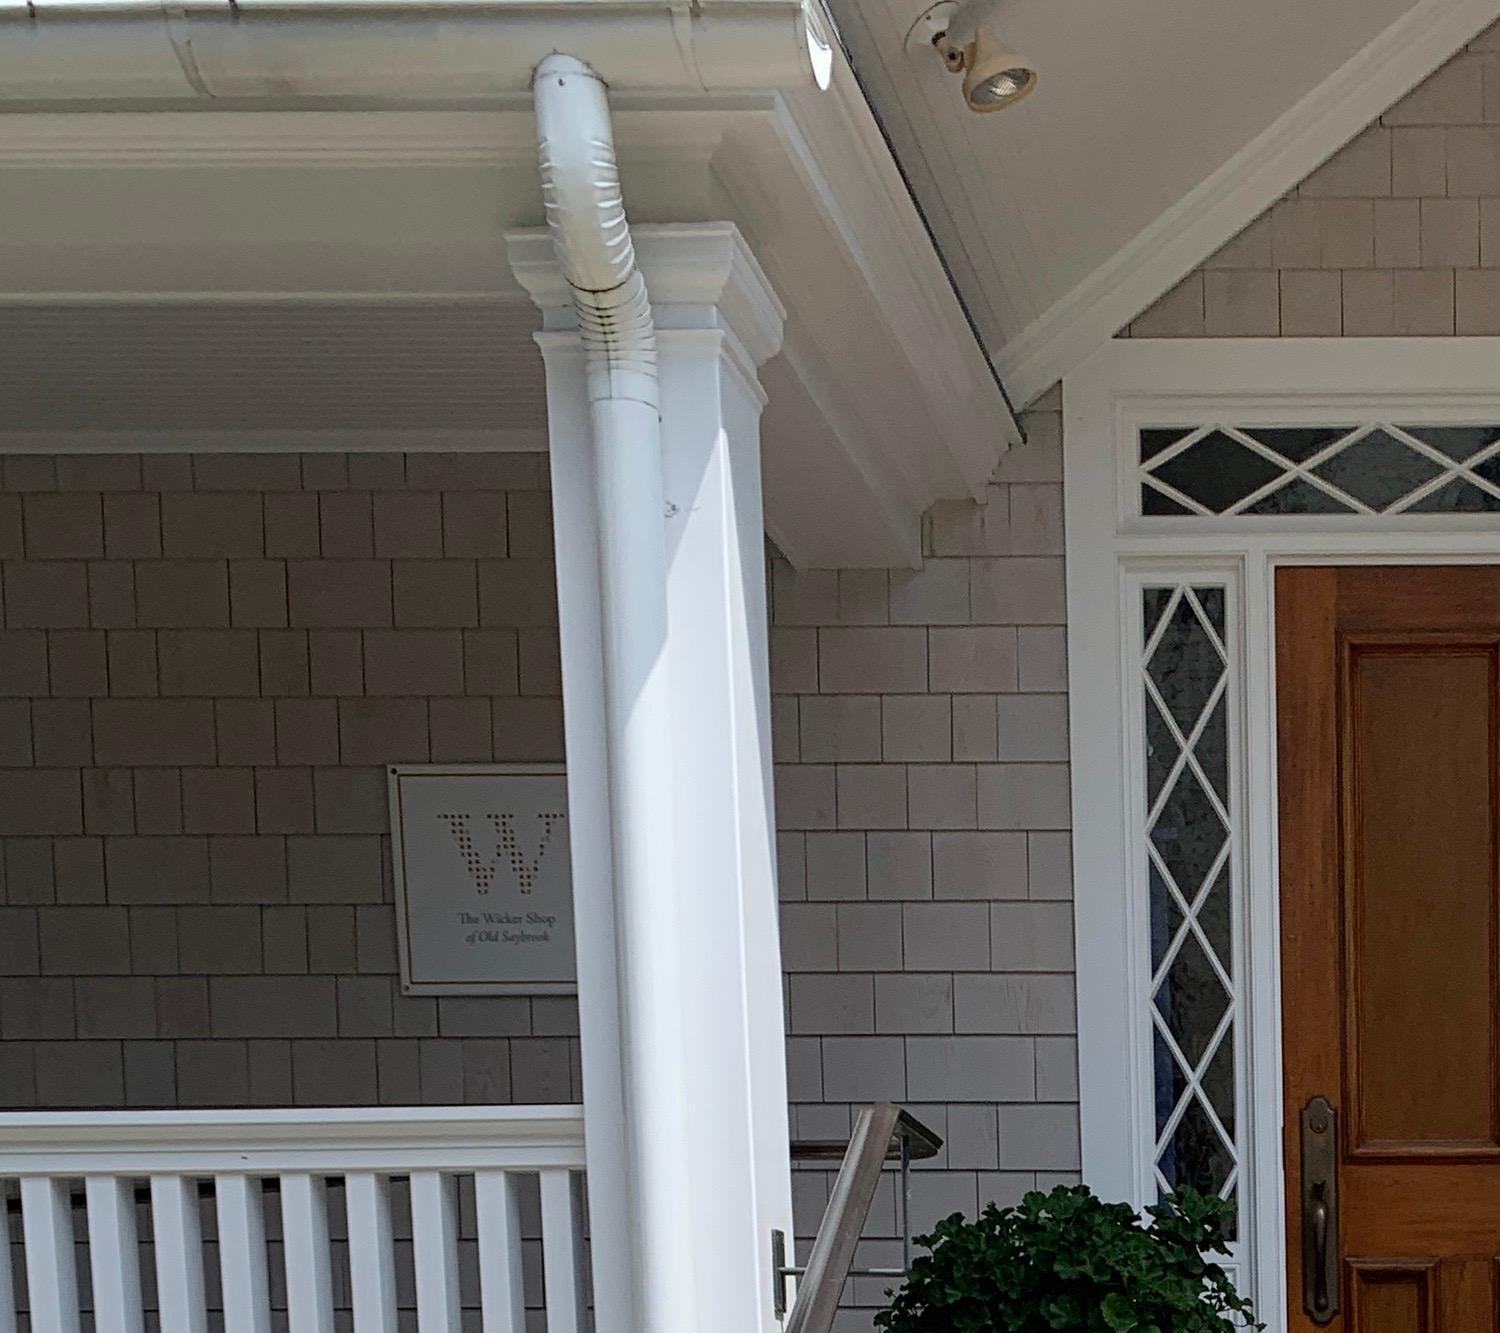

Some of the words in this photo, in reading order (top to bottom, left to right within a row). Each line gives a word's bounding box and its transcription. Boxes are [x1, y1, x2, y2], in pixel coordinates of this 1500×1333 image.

[437, 813, 565, 895] W
[457, 912, 479, 924] The
[483, 912, 522, 924] Wicker
[526, 912, 556, 927] Shop
[465, 930, 478, 945] of
[479, 930, 499, 942] Old
[502, 930, 550, 945] Saybrook
